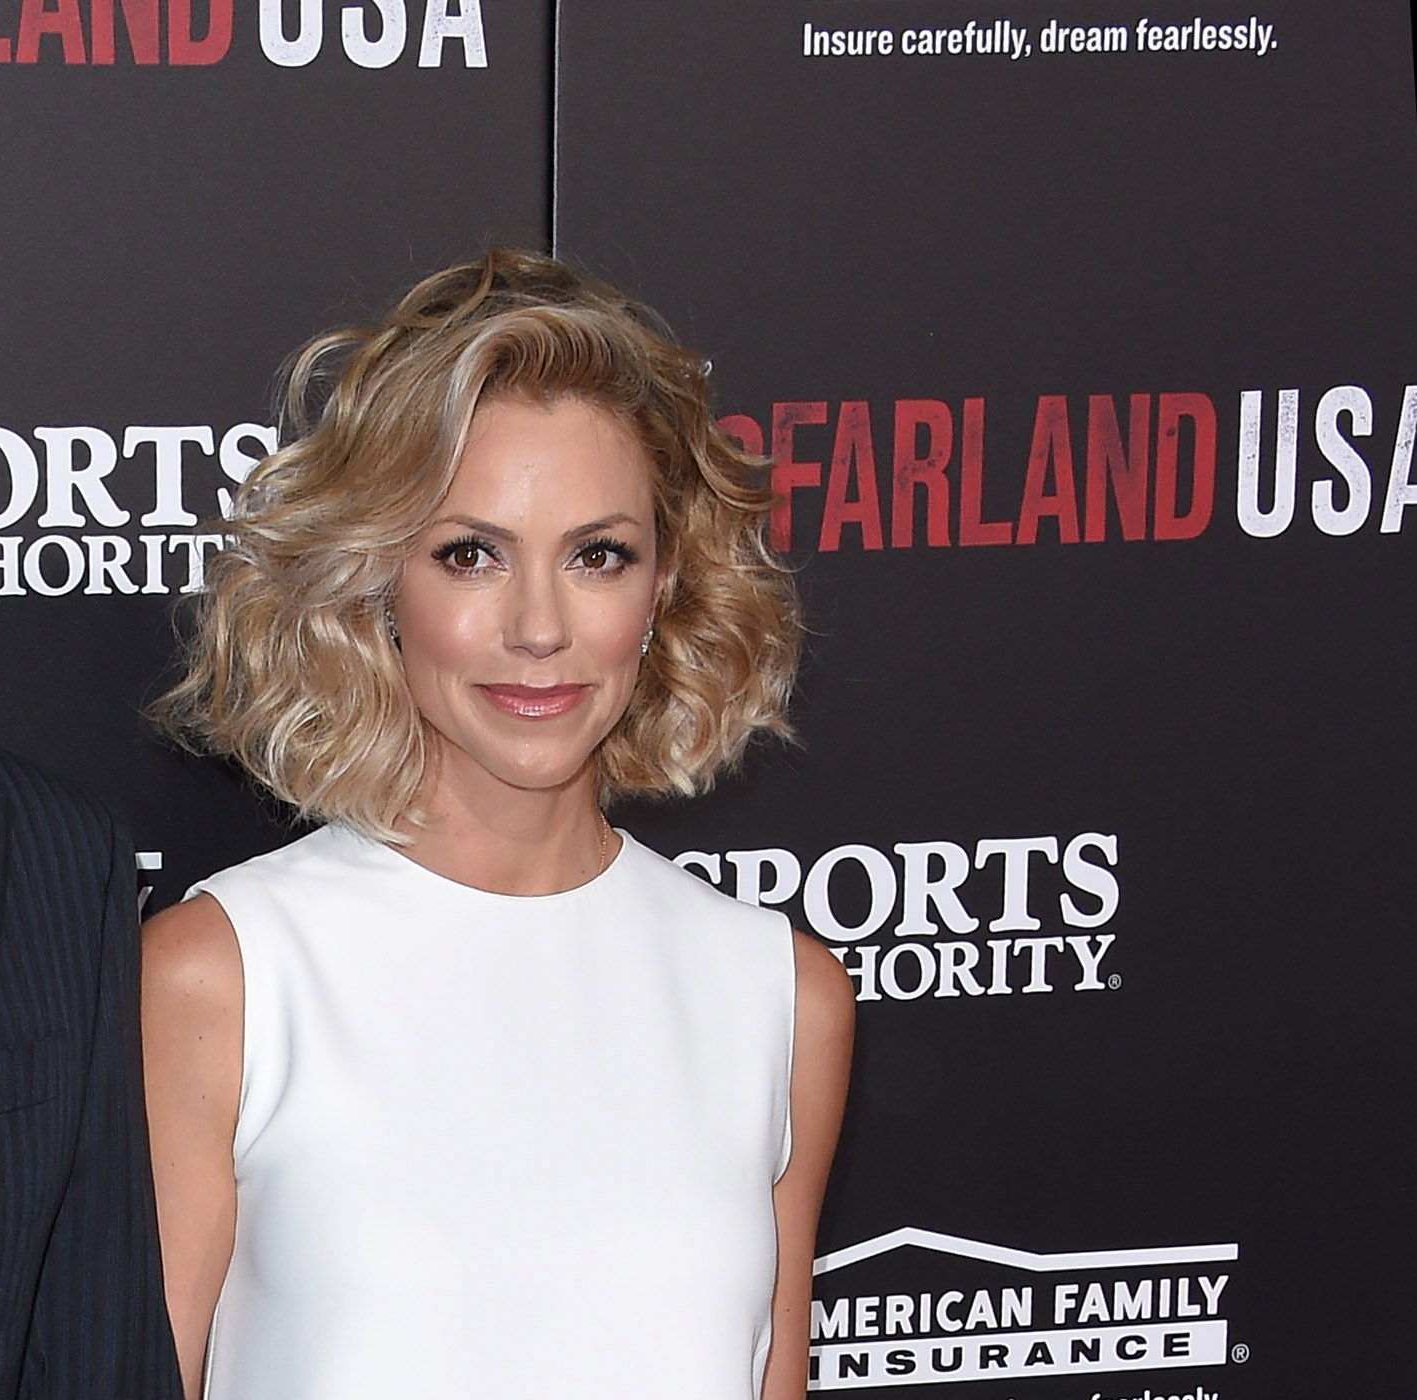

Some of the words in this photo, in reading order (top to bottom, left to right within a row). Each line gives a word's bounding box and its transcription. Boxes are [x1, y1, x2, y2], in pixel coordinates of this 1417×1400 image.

[803, 23, 893, 56] Insure
[901, 20, 1031, 60] carefully,
[1040, 19, 1127, 52] dream
[1136, 17, 1277, 56] fearlessly.
[1054, 1275, 1229, 1325] FAMILY
[809, 1332, 1191, 1380] INSURANCE
